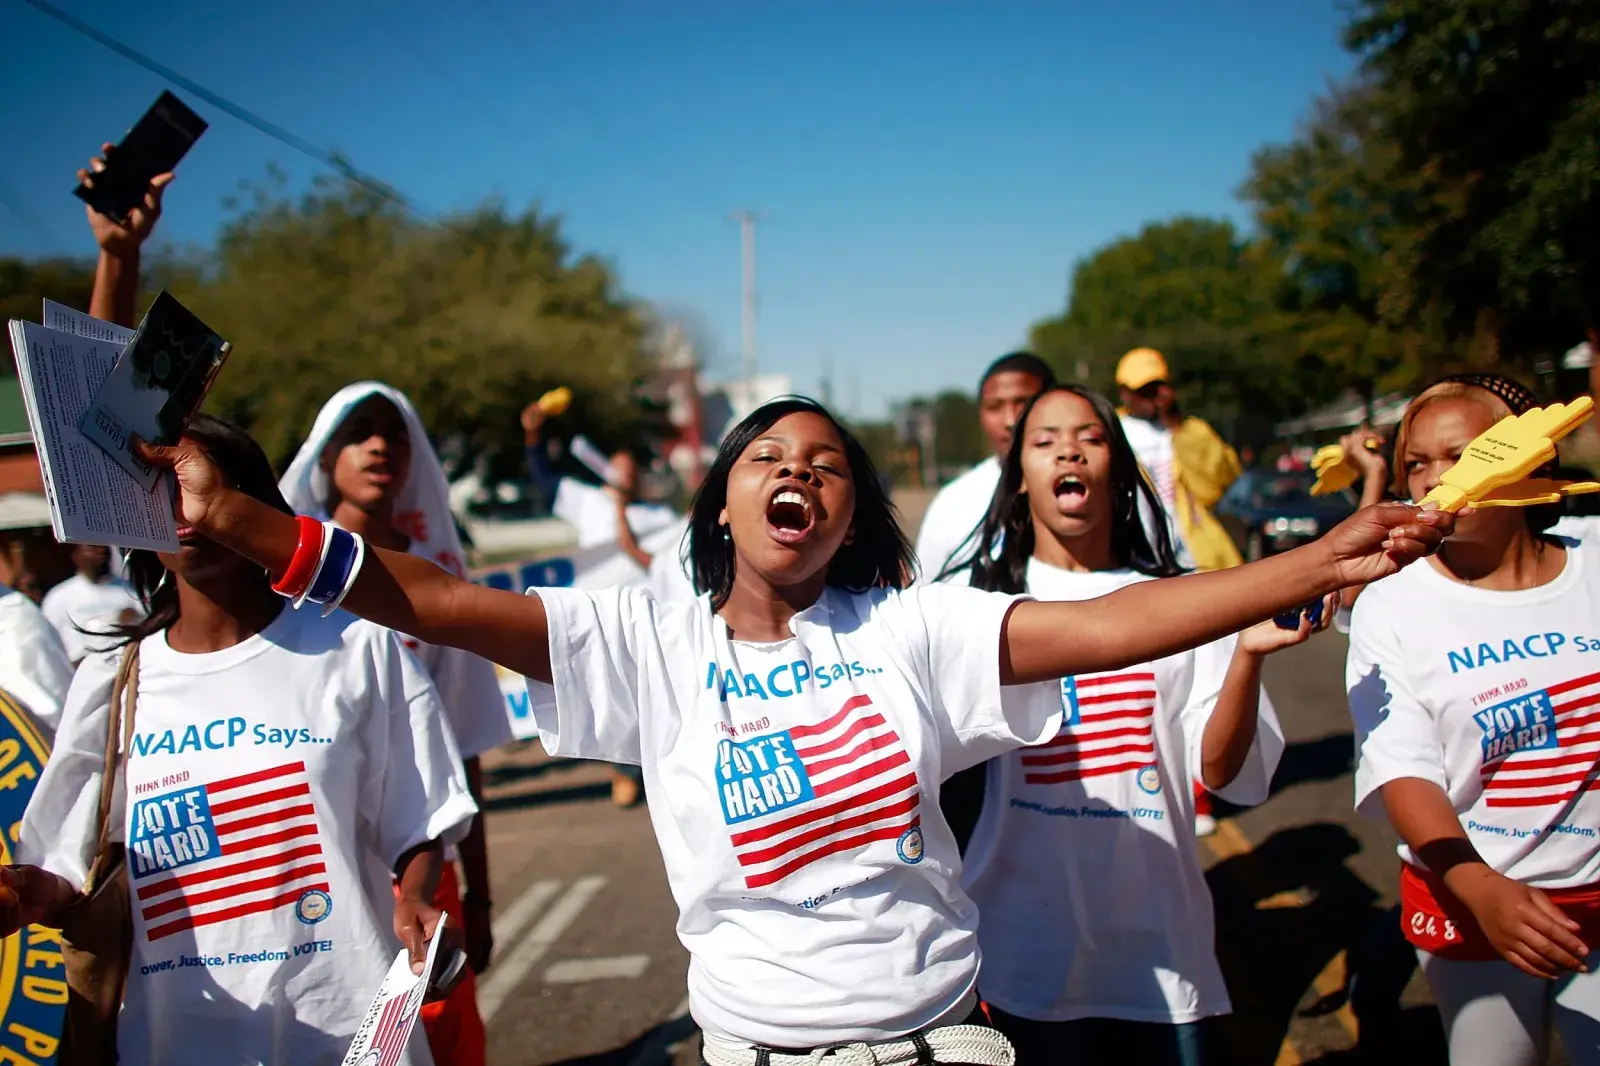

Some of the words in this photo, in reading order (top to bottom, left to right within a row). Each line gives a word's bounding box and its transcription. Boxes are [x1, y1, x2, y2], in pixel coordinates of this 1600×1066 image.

[1447, 632, 1566, 673] NAACP
[1471, 686, 1502, 706] THINK
[1502, 677, 1528, 693] HARD
[740, 716, 771, 734] HARD
[1478, 694, 1548, 740] VOTE
[130, 717, 247, 759] NAACP
[253, 724, 332, 748] Says...
[717, 736, 794, 779] VOTE
[1486, 723, 1548, 760] HARD
[135, 779, 160, 794] HINK
[162, 770, 190, 787] HARD
[723, 765, 802, 819] HARD
[1468, 820, 1508, 836] Power,
[133, 824, 210, 873] HARD
[141, 959, 175, 975] ower,
[178, 954, 225, 968] Justice,
[228, 949, 291, 965] Freedom,
[294, 940, 332, 957] VOTE!
